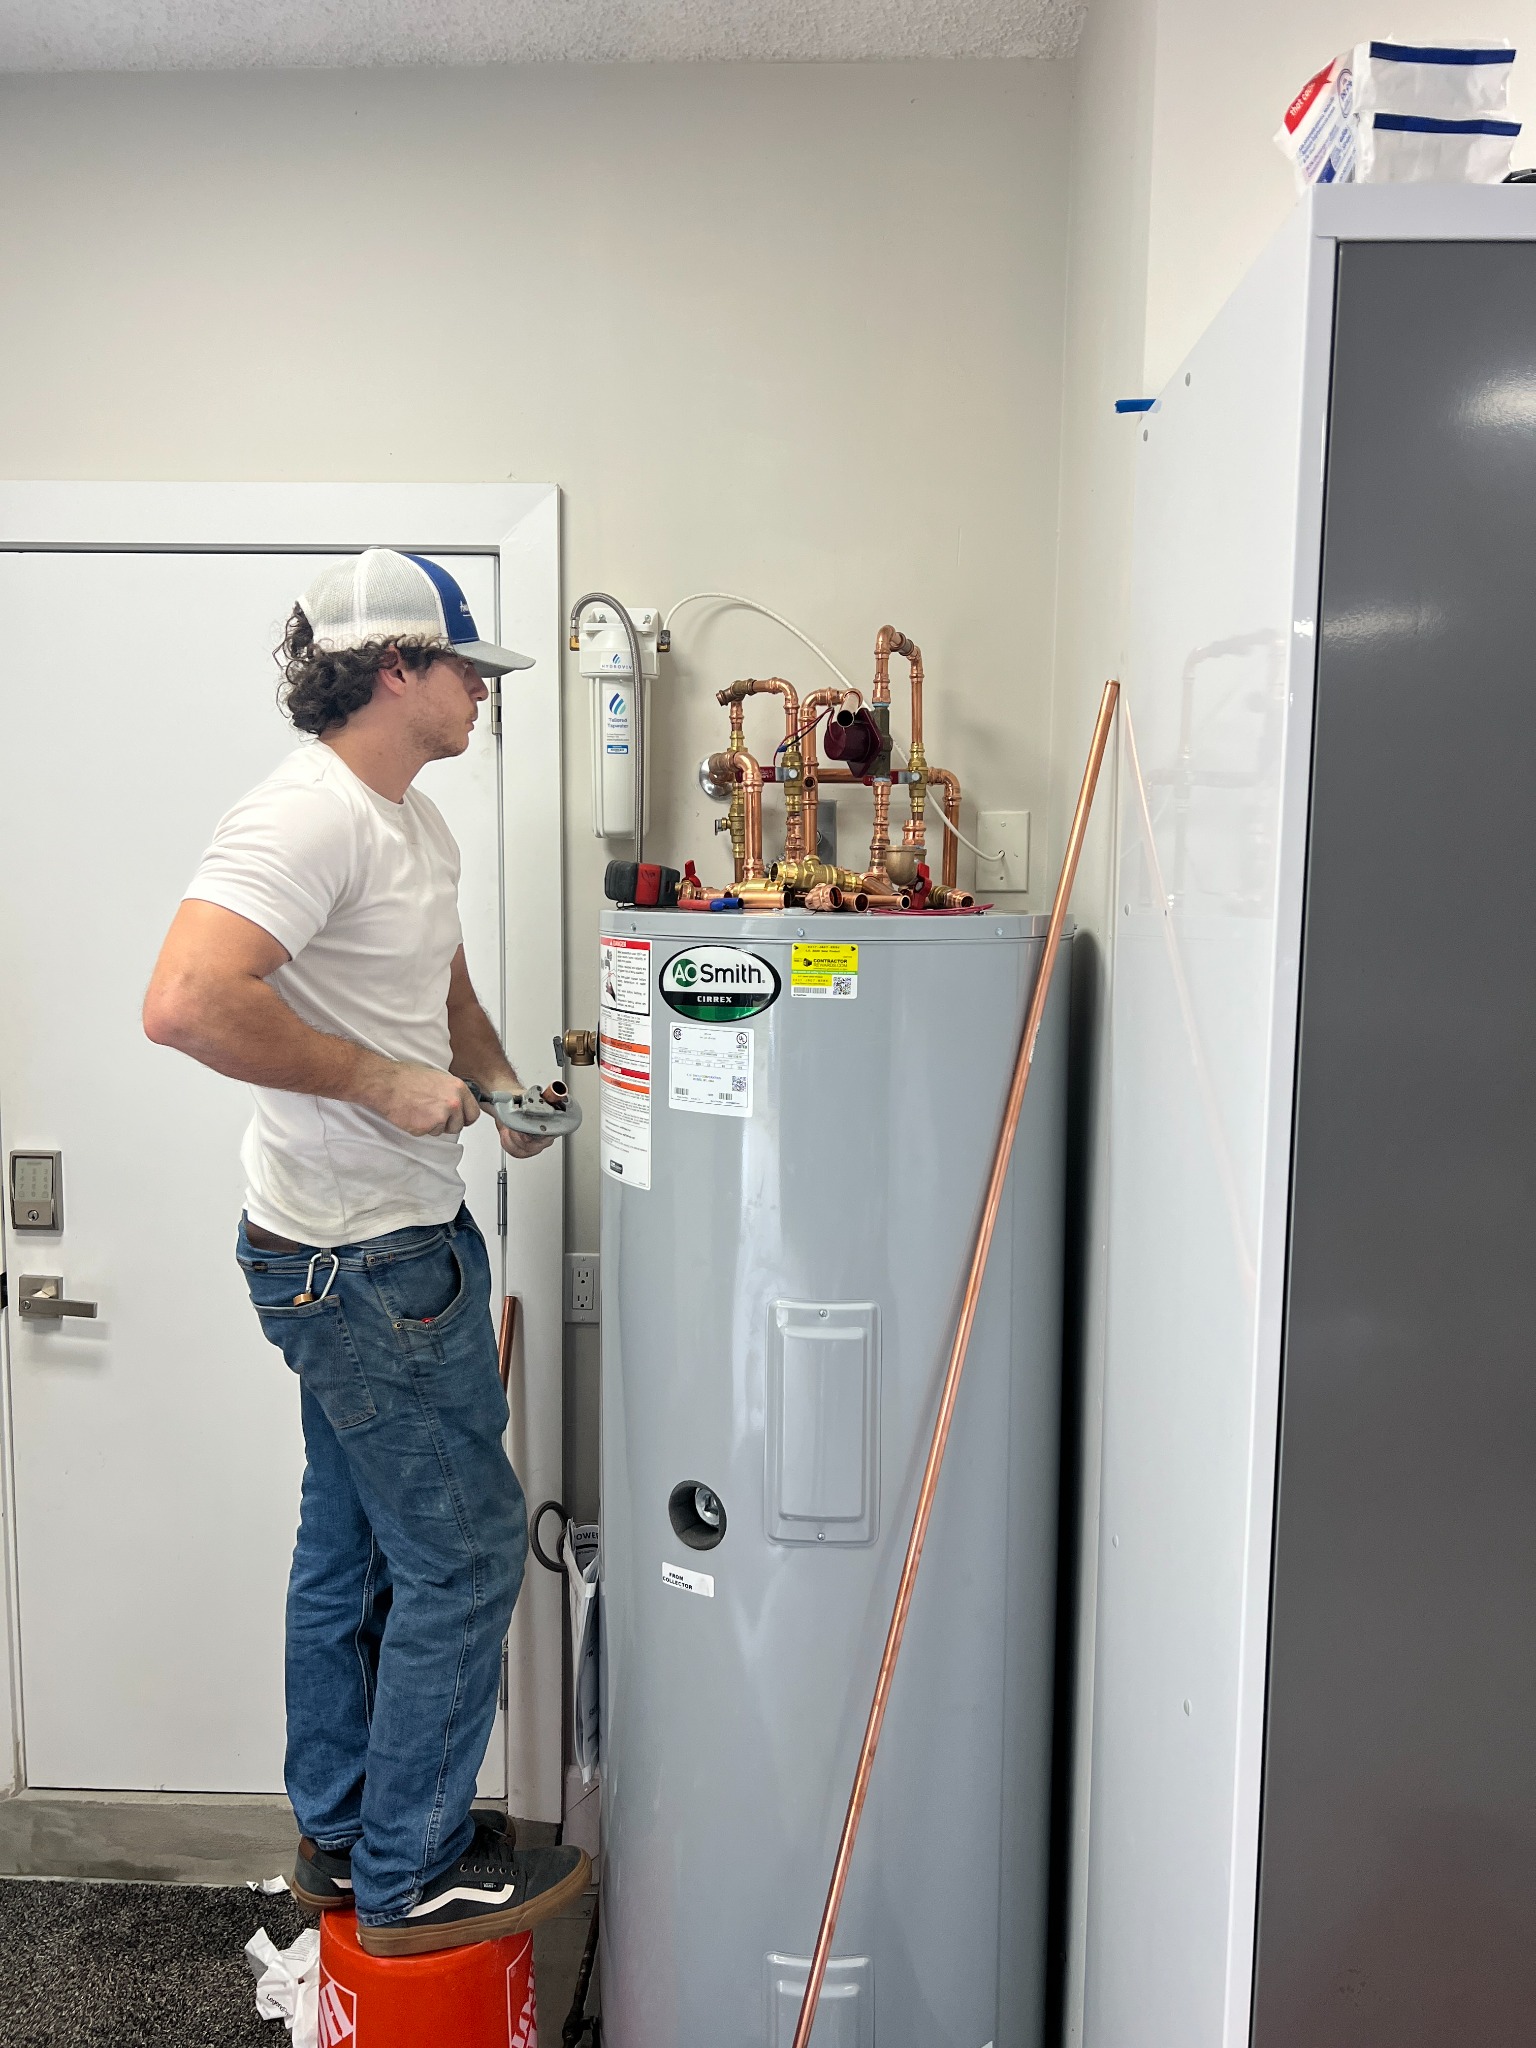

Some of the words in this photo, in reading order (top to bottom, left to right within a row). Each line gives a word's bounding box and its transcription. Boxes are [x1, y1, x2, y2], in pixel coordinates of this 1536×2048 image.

[700, 963, 761, 984] Smith
[696, 995, 732, 1003] CIRREX
[575, 1531, 598, 1540] OWE
[669, 1572, 684, 1581] FROM
[662, 1576, 693, 1590] COLLECTOR
